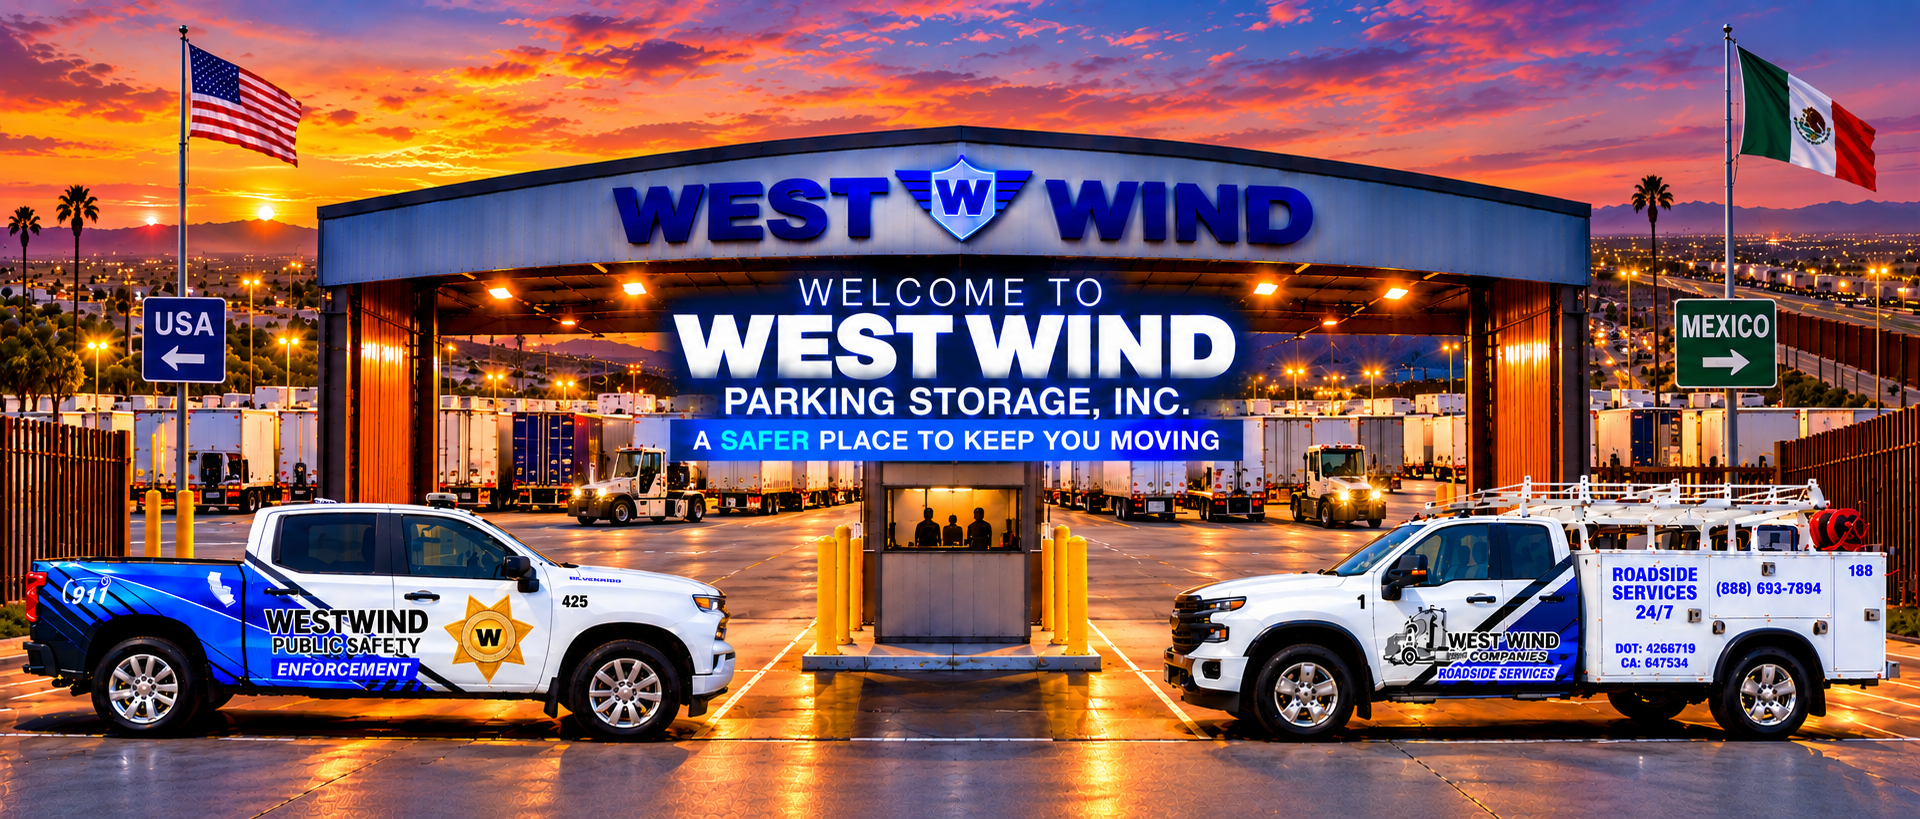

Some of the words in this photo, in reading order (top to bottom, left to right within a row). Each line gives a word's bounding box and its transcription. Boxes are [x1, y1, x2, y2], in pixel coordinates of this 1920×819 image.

[612, 177, 889, 245] WEST
[934, 179, 992, 216] W
[1045, 179, 1314, 245] WIND
[155, 311, 214, 337] USA
[1682, 313, 1770, 339] MEXICO
[1612, 567, 1698, 582] ROADSIDE
[1848, 564, 1873, 577] 188
[1612, 584, 1698, 601] SERVICES
[1716, 581, 1751, 597] (888)
[1756, 582, 1822, 595] 693-7894
[562, 594, 588, 608] 425
[1357, 594, 1365, 609] 1
[1635, 604, 1674, 621] 24/7
[265, 609, 429, 634] WESTWIND
[272, 636, 343, 654] PUBLIC
[347, 636, 421, 654] SAFETY
[475, 628, 503, 647] W
[1448, 632, 1502, 649] WEST
[1506, 632, 1560, 649] WIND
[1469, 651, 1548, 662] COMPANIES
[1615, 643, 1642, 654] DOT:
[1646, 643, 1696, 654] 4266719
[277, 662, 411, 677] ENFORCEMENT
[1621, 657, 1641, 668] CA:
[1645, 657, 1688, 668] 647534
[1438, 668, 1497, 679] ROADSIDE
[1499, 668, 1555, 679] SERVICES
